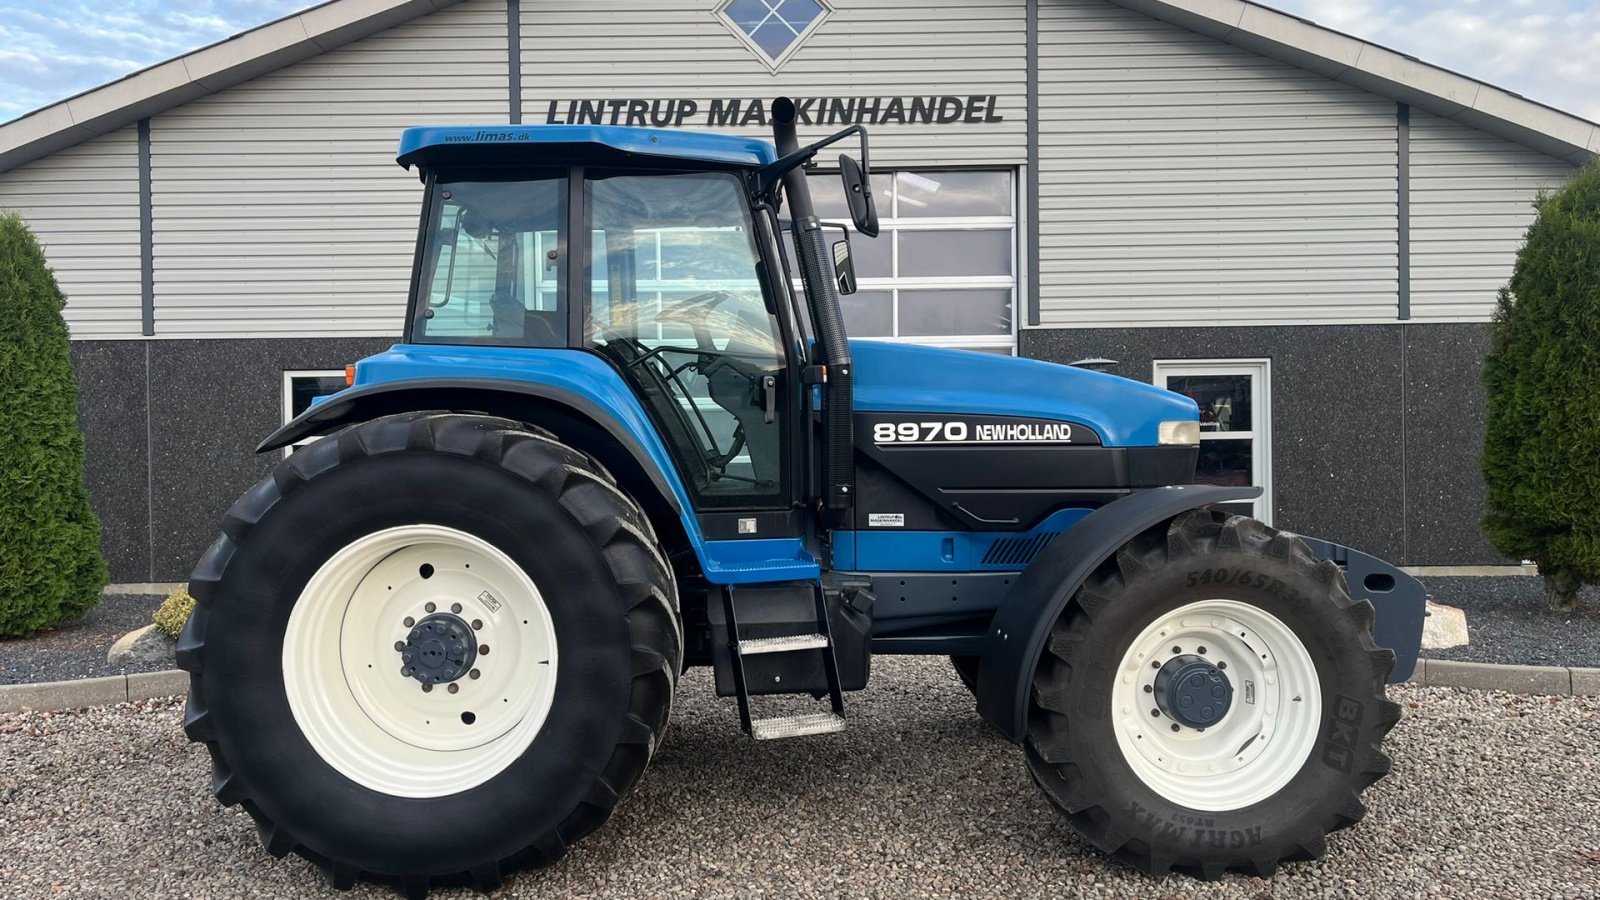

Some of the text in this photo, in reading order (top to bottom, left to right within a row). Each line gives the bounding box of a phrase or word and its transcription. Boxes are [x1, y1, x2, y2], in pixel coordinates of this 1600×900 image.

[546, 95, 1004, 126] LINTRUP MAKINHANDEL
[444, 131, 531, 143] www.limas.dk
[873, 421, 968, 442] 8970
[1327, 697, 1360, 772] BKT
